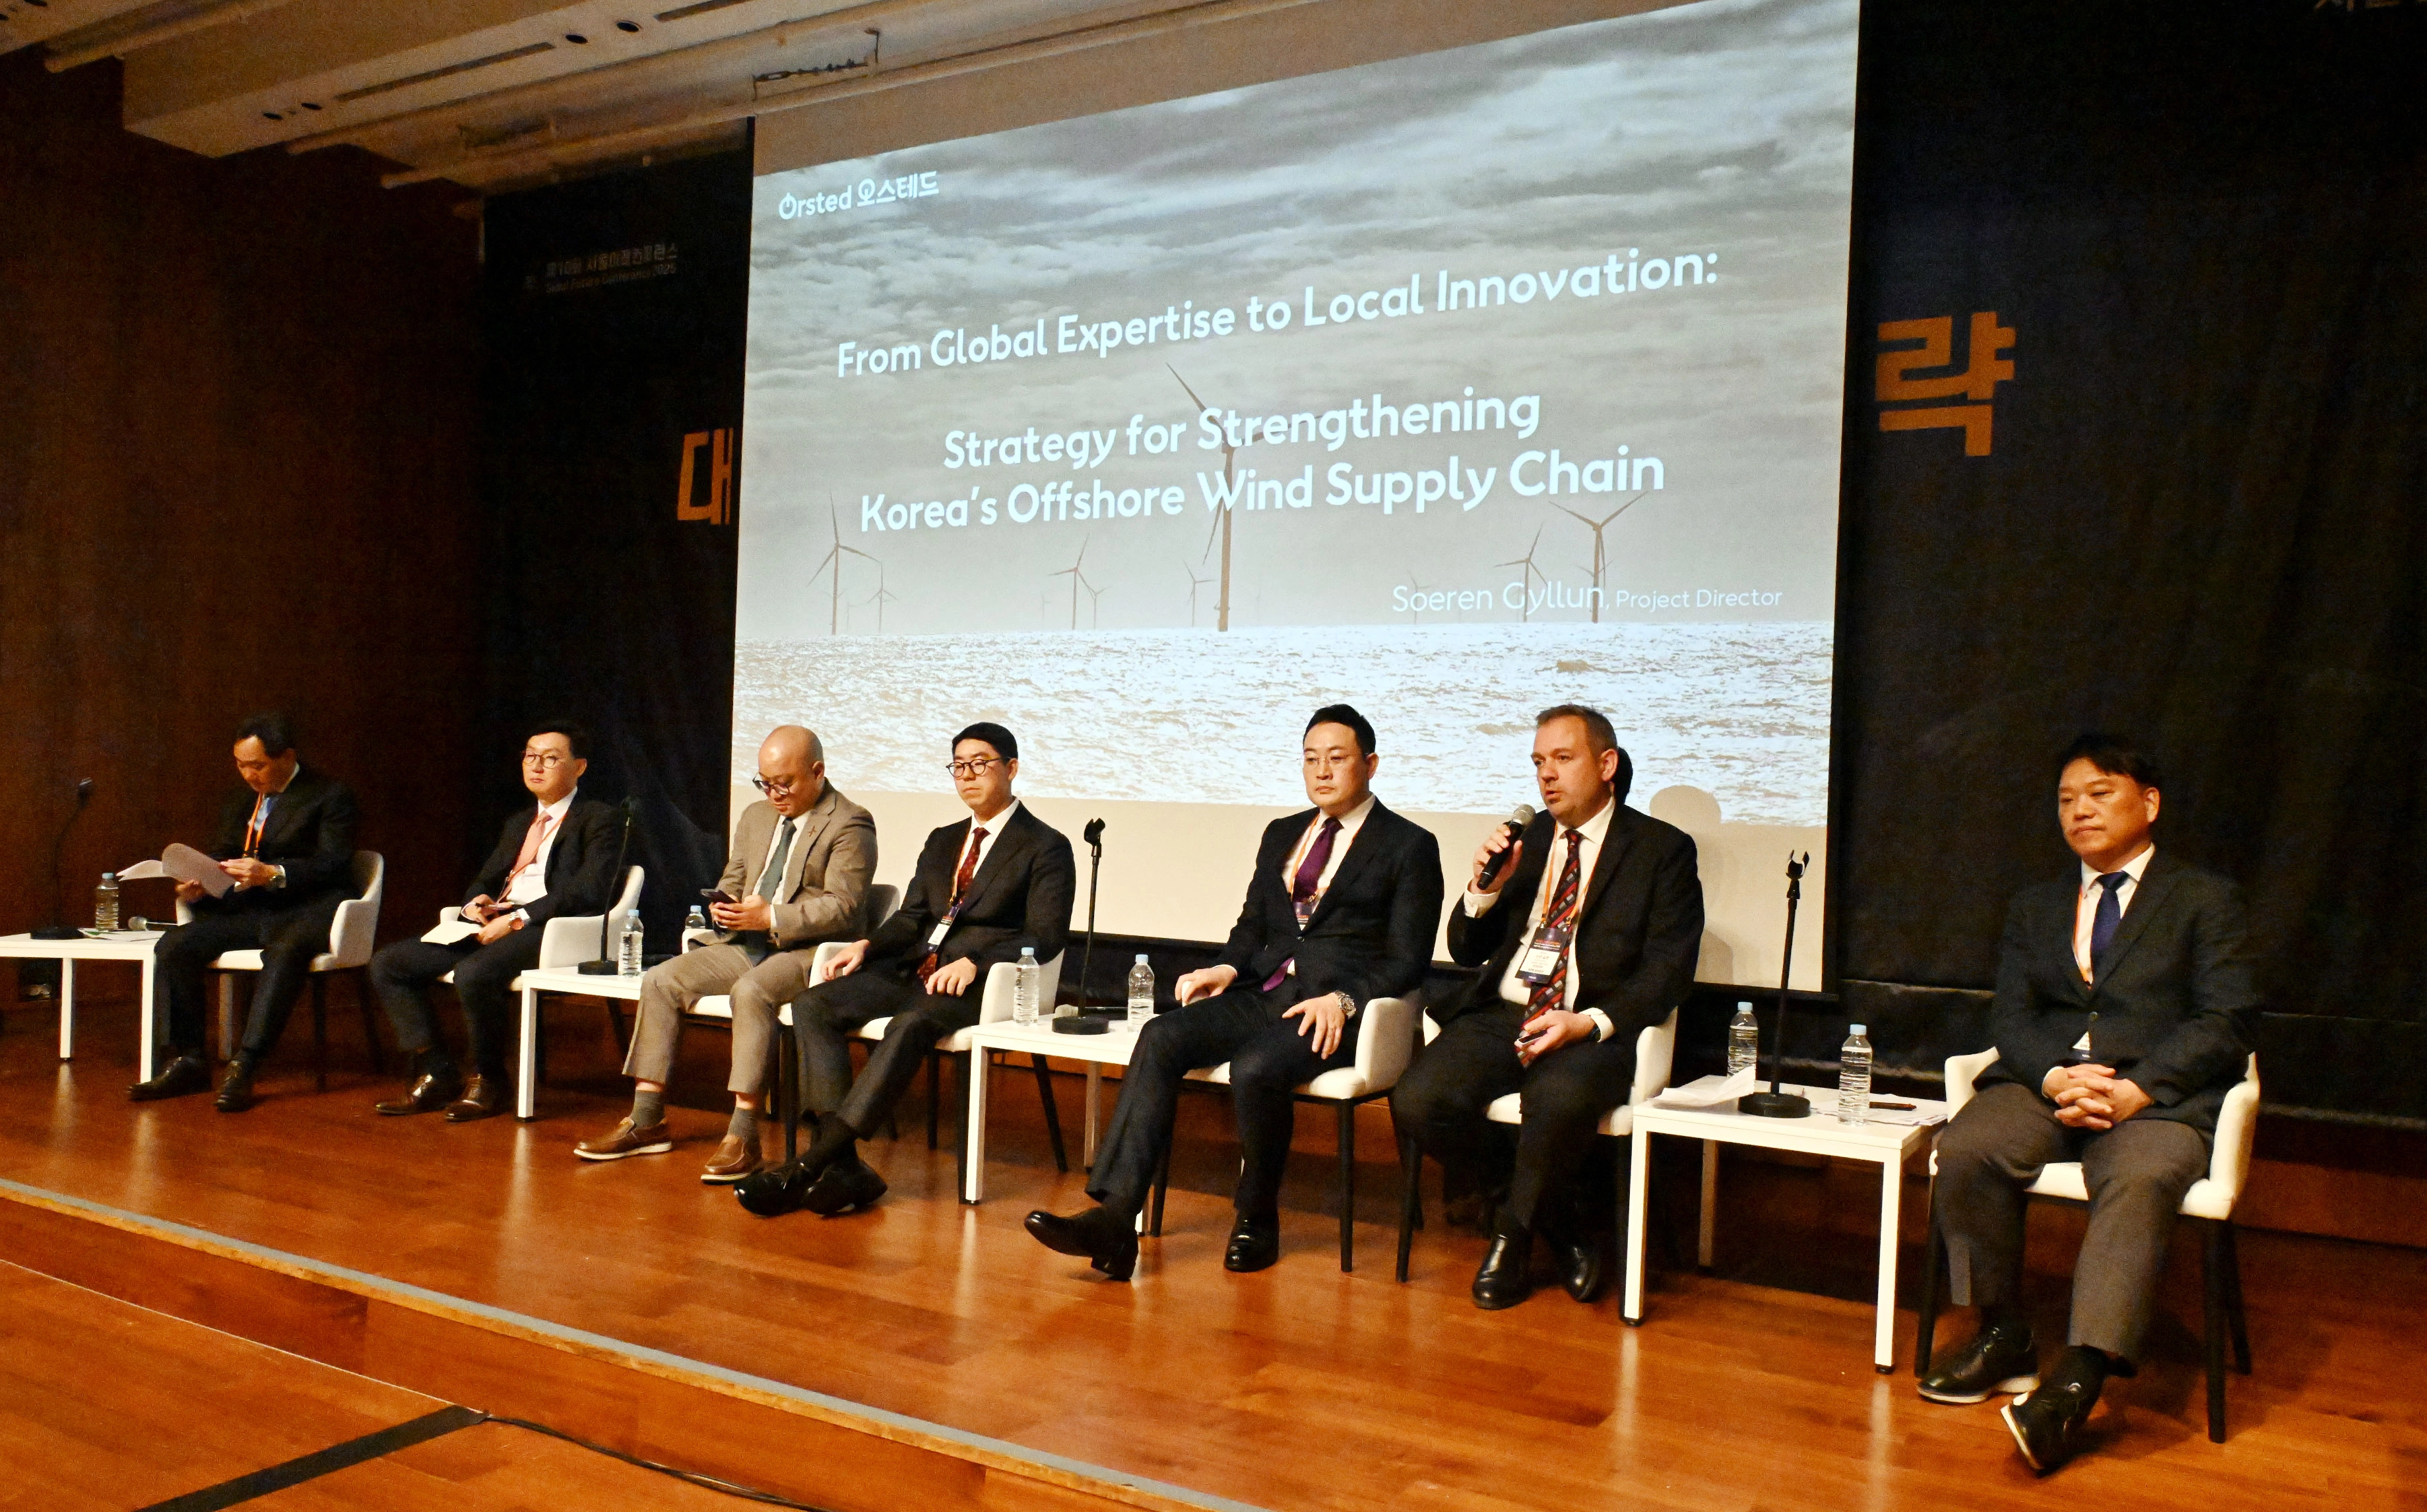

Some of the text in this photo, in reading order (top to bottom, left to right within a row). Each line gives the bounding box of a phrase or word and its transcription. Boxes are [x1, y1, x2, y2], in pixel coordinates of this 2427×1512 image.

[857, 171, 939, 207] 오스테드
[837, 247, 1719, 377] From Global Expertise to Local Innovation:
[1877, 311, 2017, 457] 략
[944, 387, 1541, 470] Strategy for Strengthening
[677, 427, 734, 525] 대
[861, 445, 1664, 532] Korea’s Offshore Wind Supply Chain
[1392, 586, 1493, 612] Soeren
[1616, 590, 1689, 613] Project
[1696, 588, 1784, 608] Director
